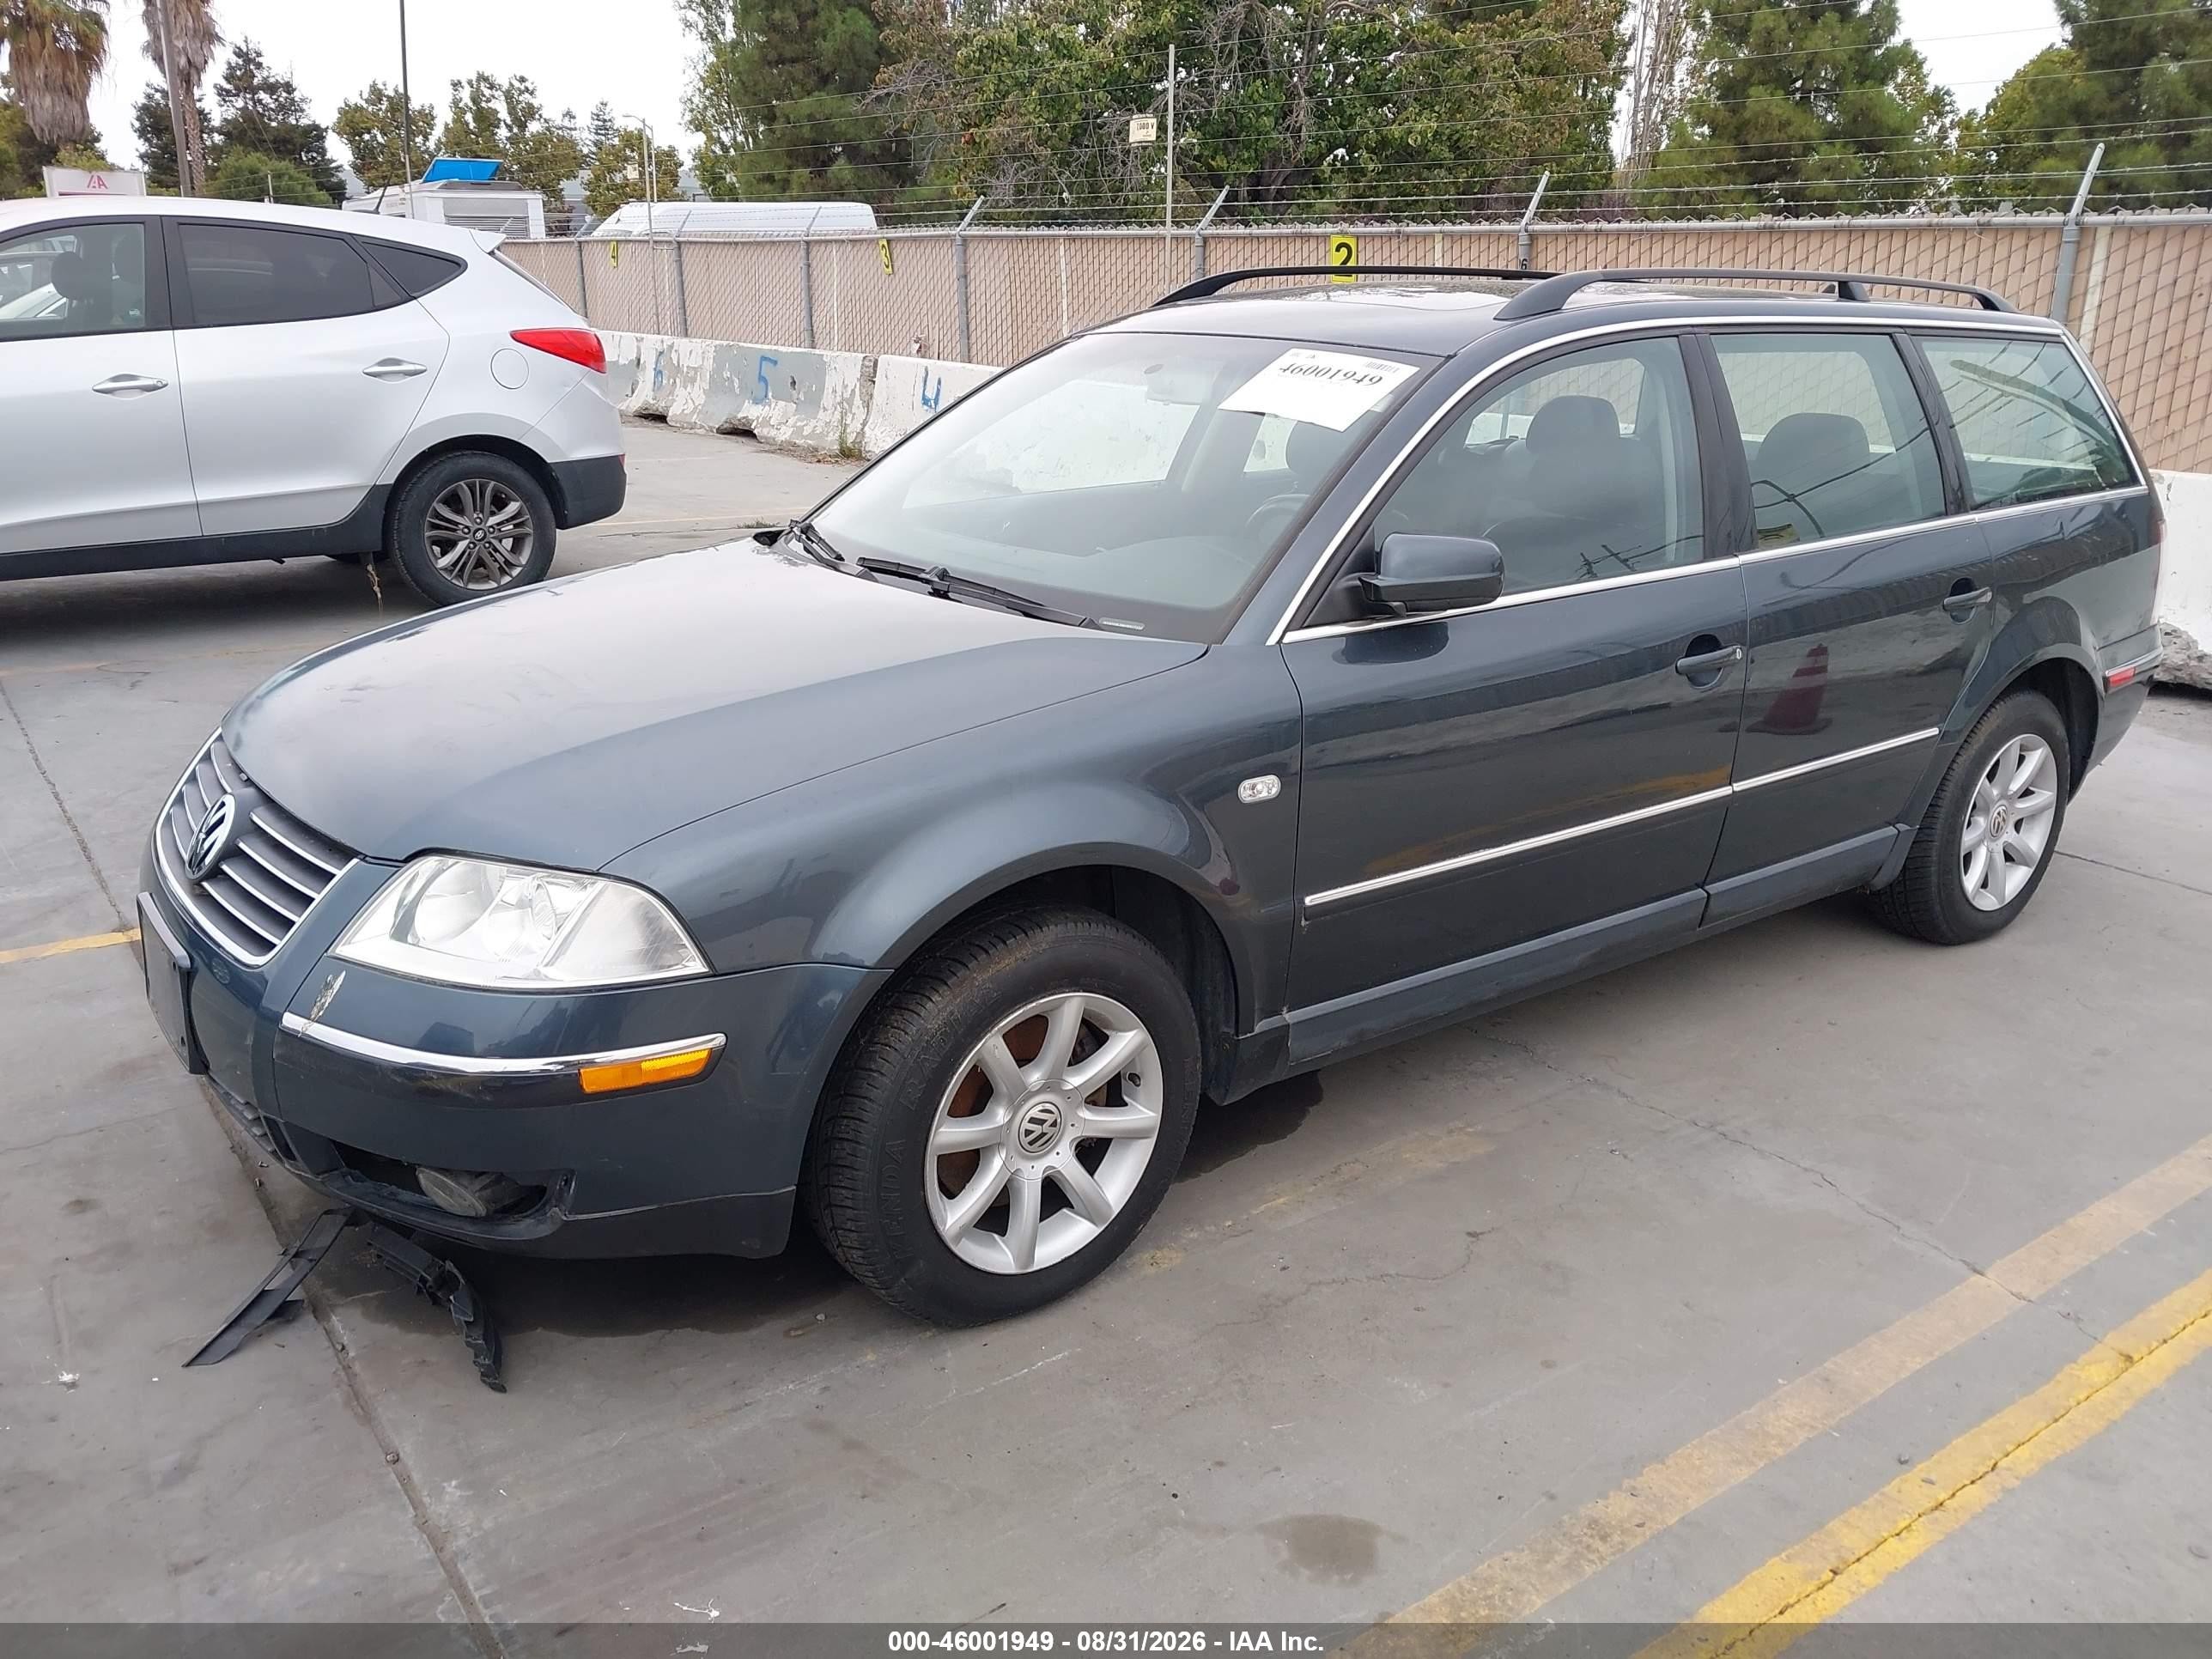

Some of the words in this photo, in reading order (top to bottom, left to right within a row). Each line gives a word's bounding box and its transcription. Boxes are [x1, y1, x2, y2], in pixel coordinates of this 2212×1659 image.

[611, 243, 617, 264] 4
[881, 243, 890, 269] 3
[1334, 241, 1353, 277] 2
[751, 356, 778, 404] 5
[1279, 362, 1383, 386] 46001949
